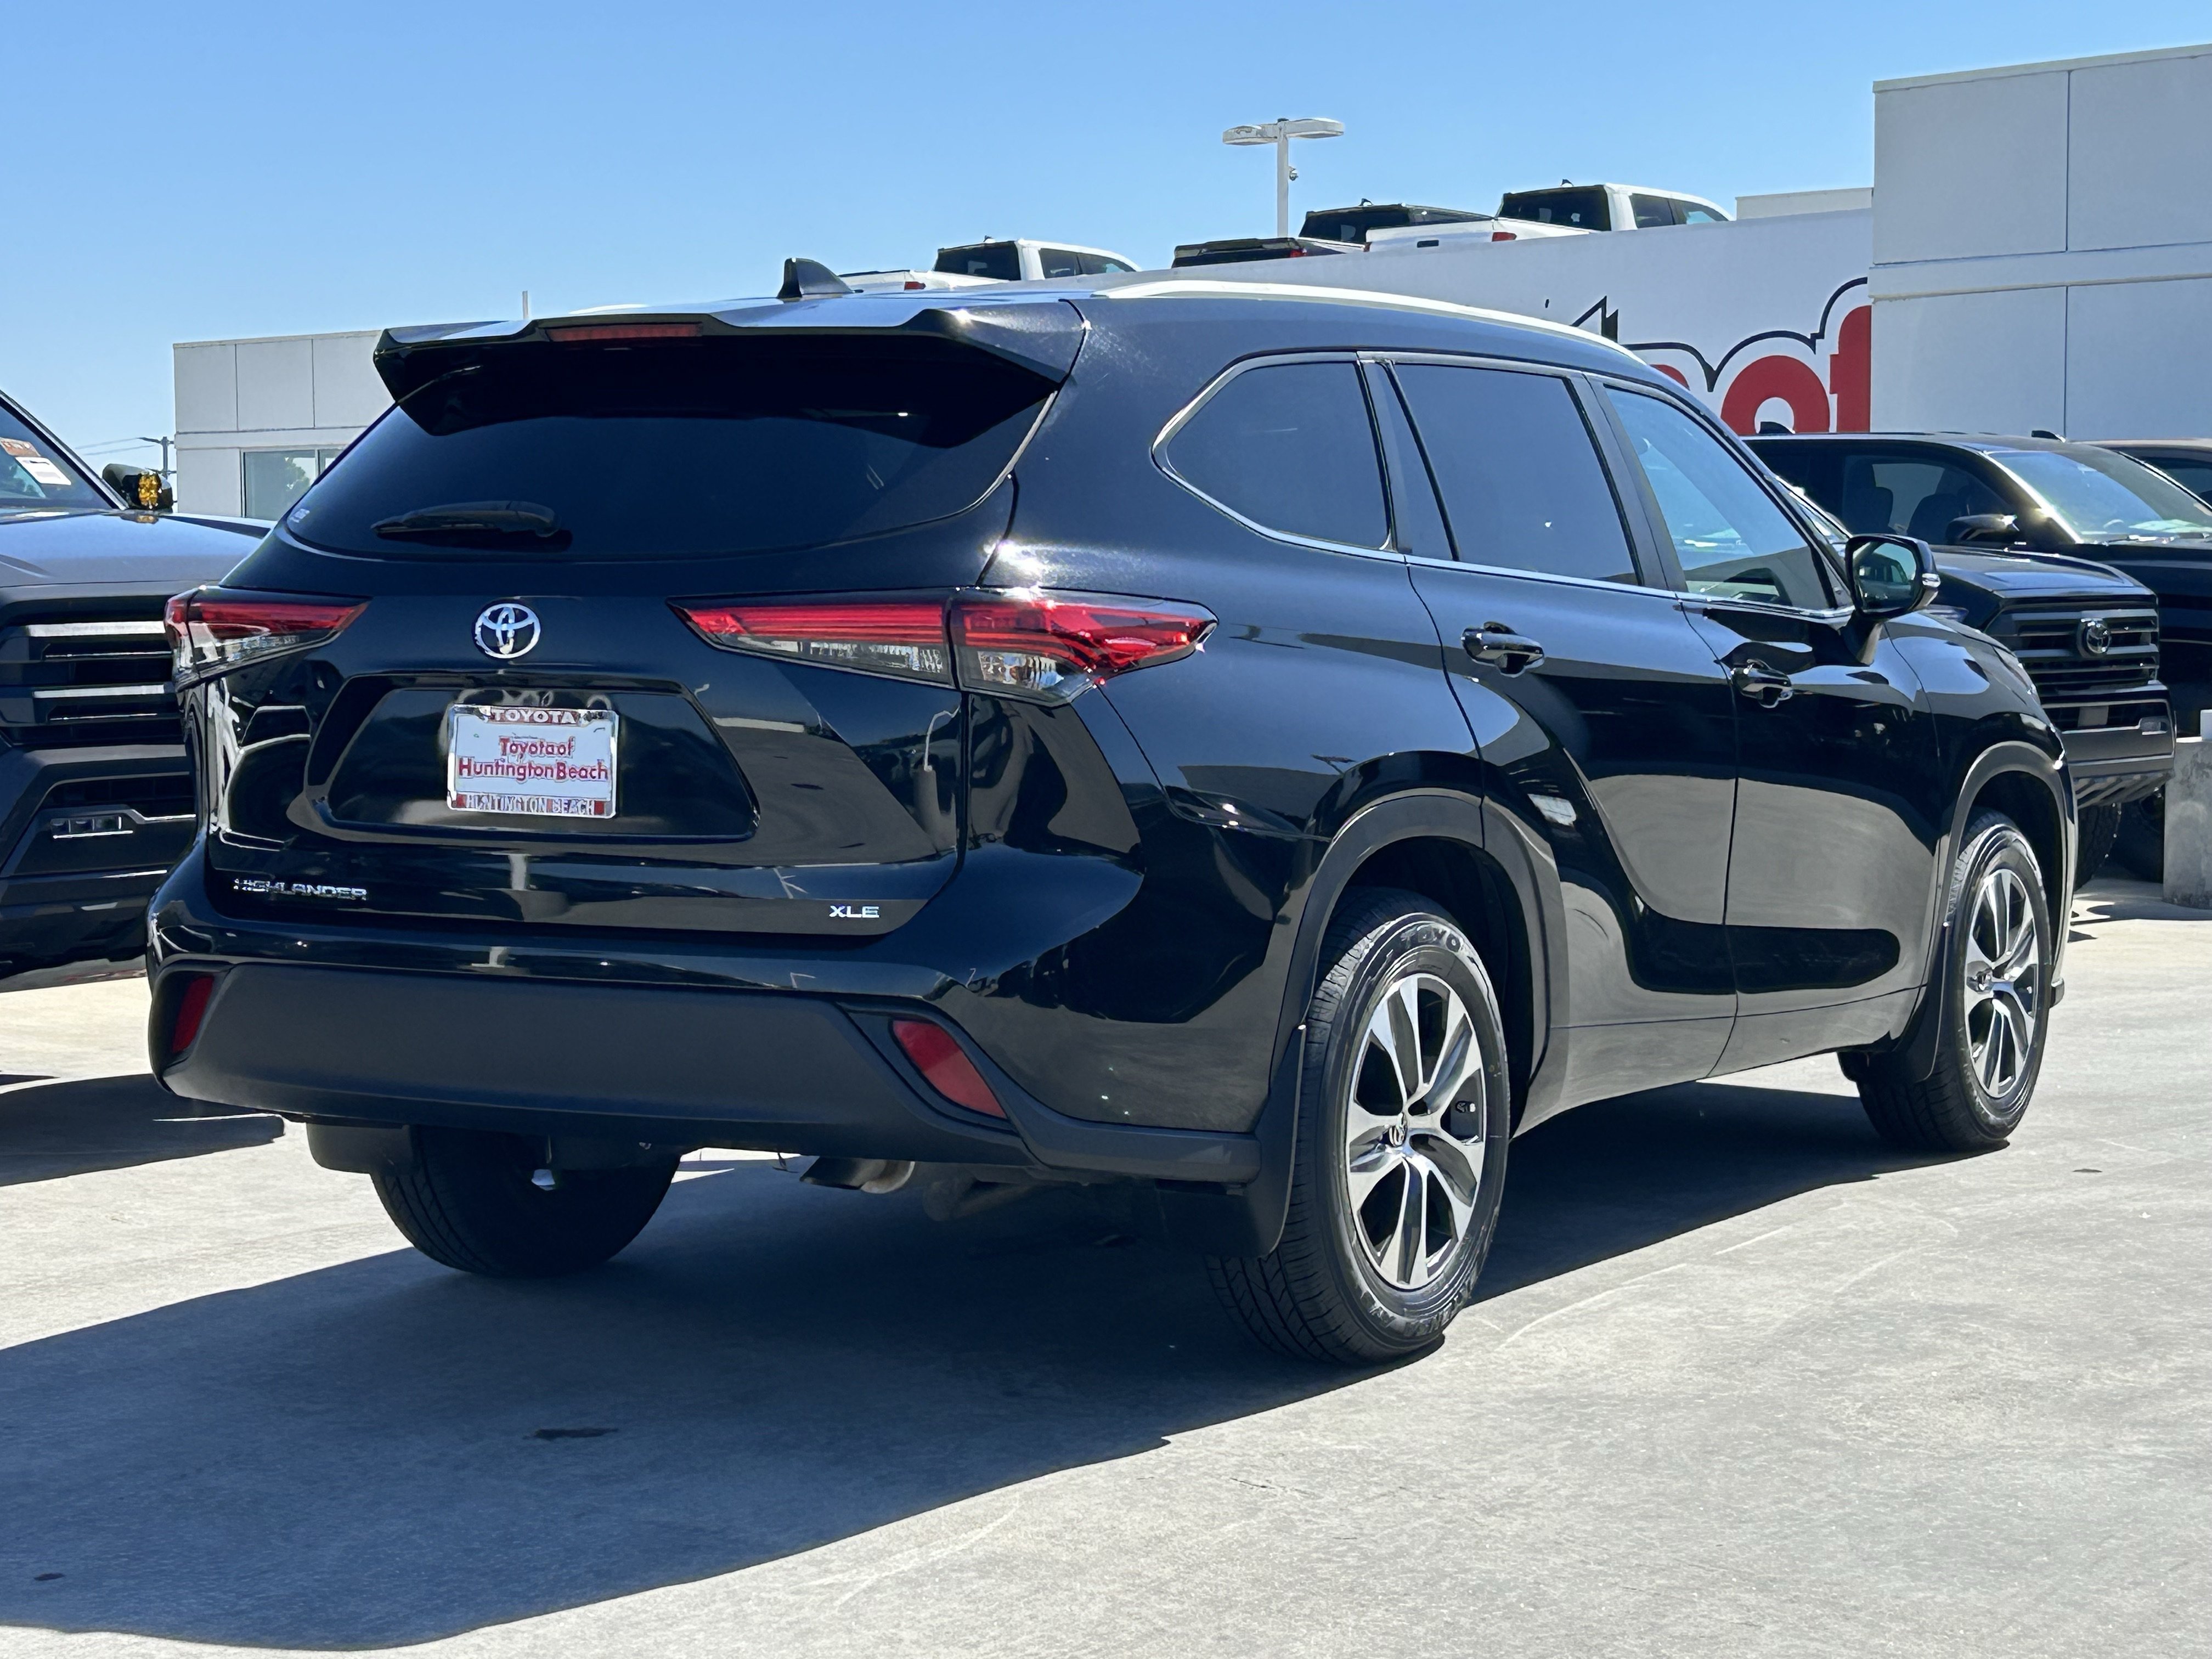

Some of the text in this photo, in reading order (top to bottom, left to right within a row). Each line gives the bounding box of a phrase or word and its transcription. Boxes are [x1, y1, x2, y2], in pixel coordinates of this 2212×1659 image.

[494, 709, 577, 724] TOYOTA
[500, 736, 574, 759] Toyota of
[459, 758, 608, 781] Huntington Beach
[552, 799, 595, 815] BEACH
[829, 905, 879, 918] XLE
